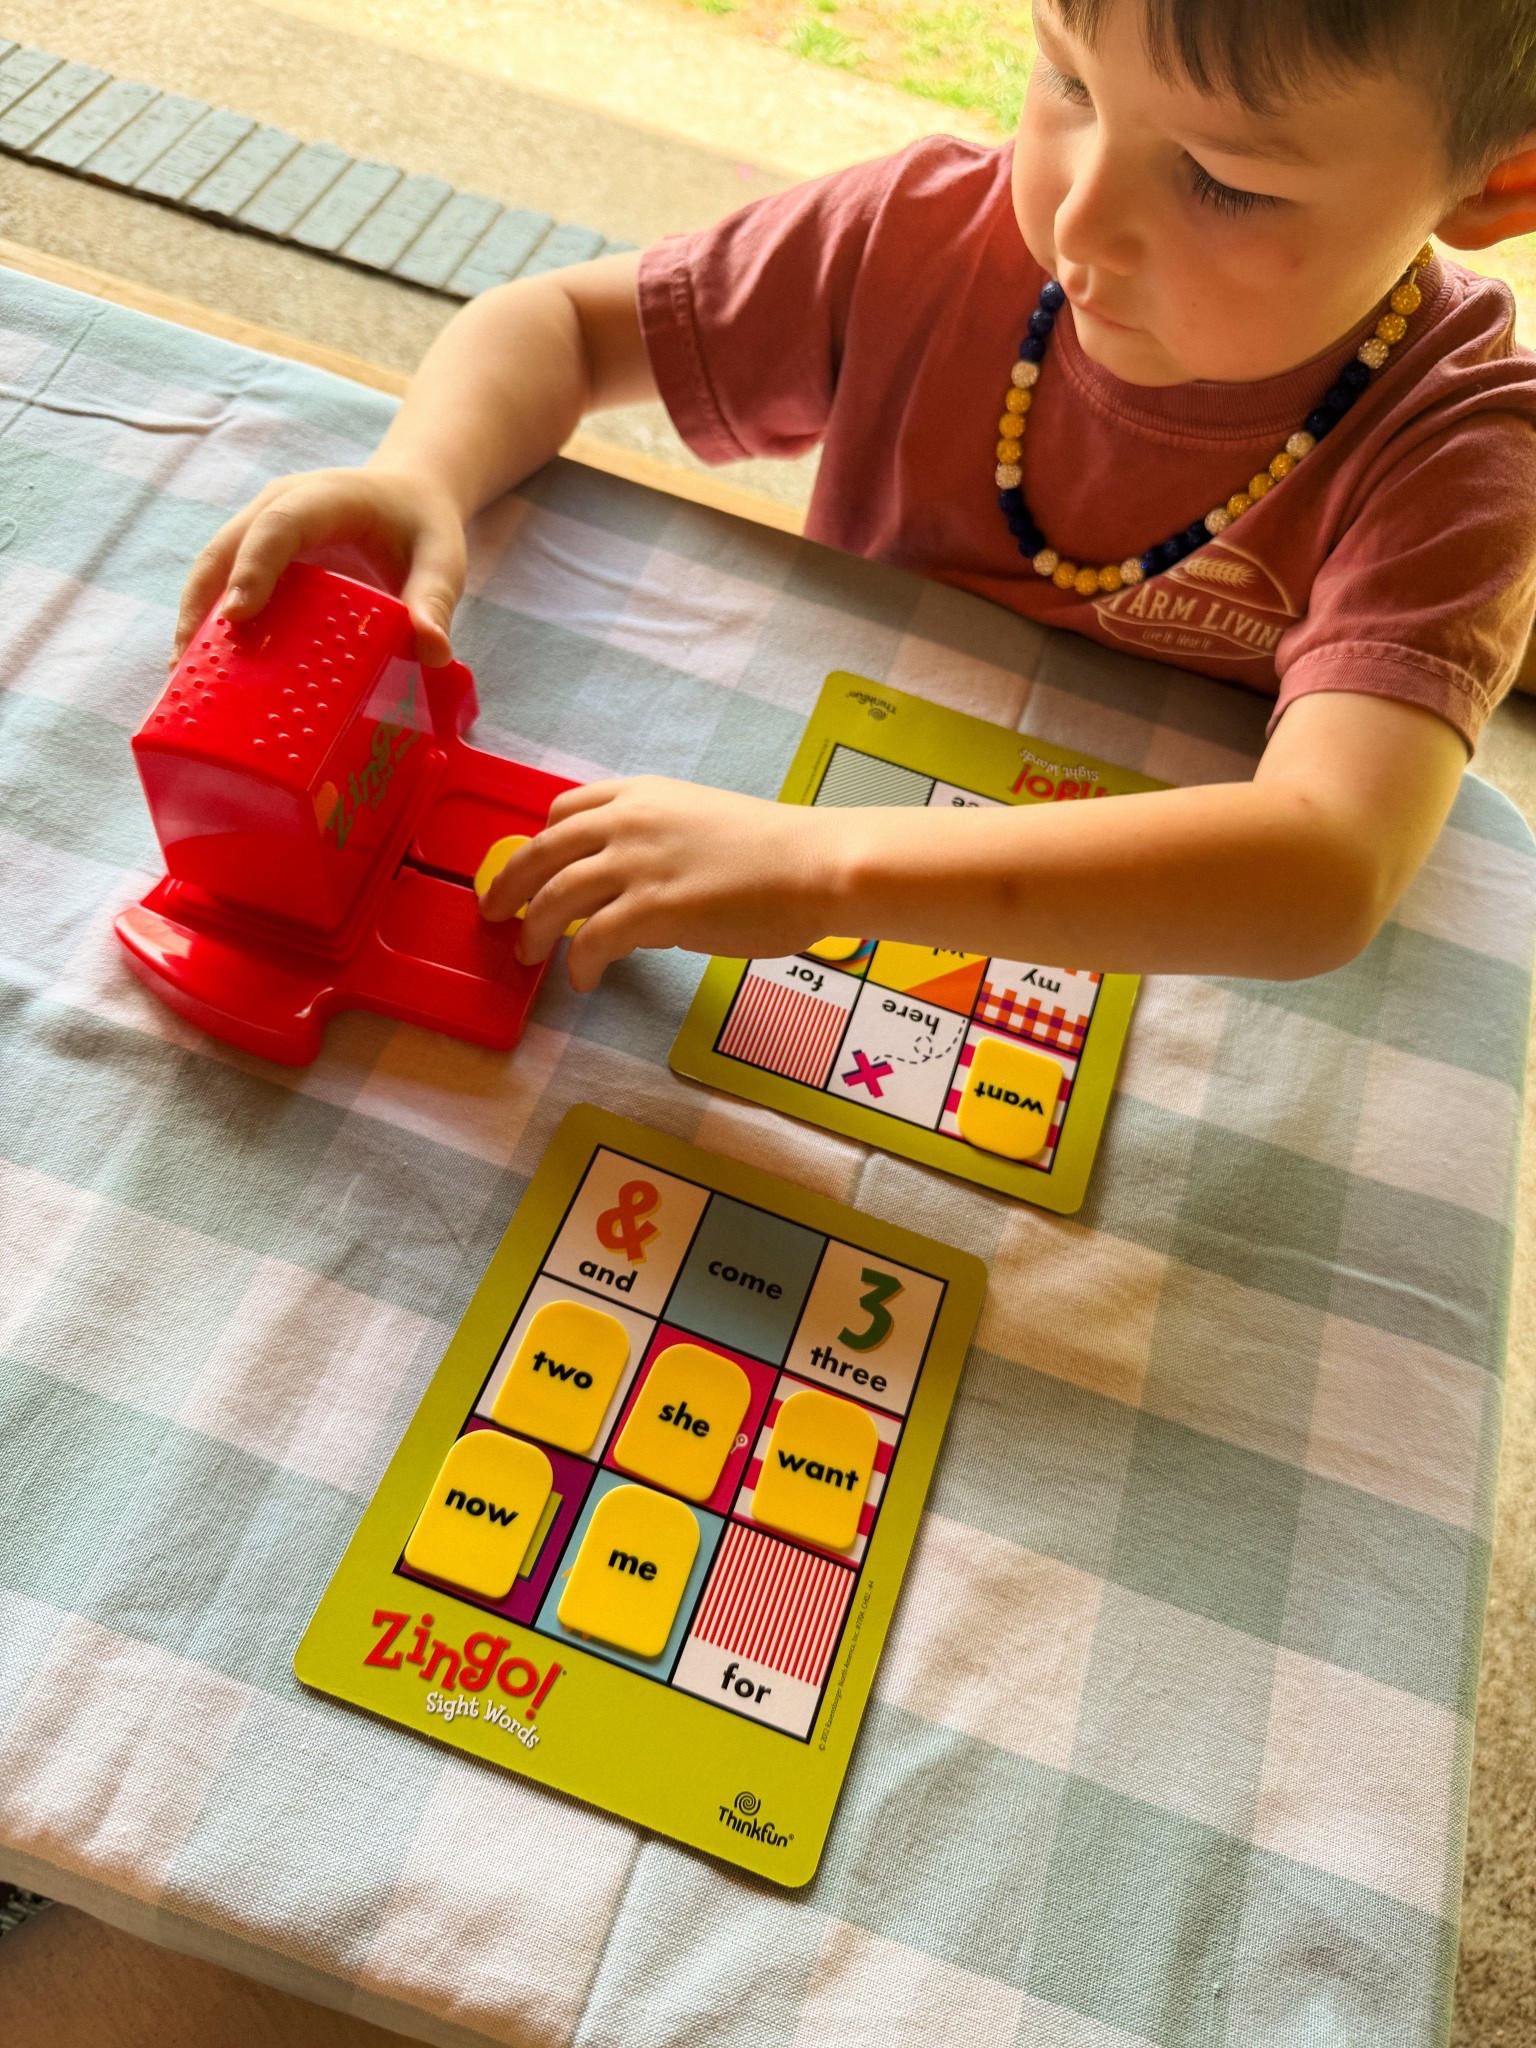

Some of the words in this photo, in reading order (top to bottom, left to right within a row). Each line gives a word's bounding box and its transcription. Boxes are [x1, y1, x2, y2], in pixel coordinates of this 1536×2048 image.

[1202, 602, 1284, 649] LIVIN
[1063, 764, 1099, 782] Sight
[786, 964, 825, 992] for
[1020, 968, 1061, 994] my
[882, 998, 940, 1035] here
[974, 1081, 1044, 1115] want
[578, 1257, 638, 1293] and
[707, 1259, 783, 1300] come
[837, 1267, 905, 1353] 3
[533, 1351, 593, 1390] two
[810, 1346, 888, 1393] three
[659, 1401, 711, 1438] she
[777, 1449, 859, 1492] want
[445, 1484, 519, 1528] now
[607, 1546, 658, 1582] me
[364, 1609, 563, 1720] Zingo!
[720, 1662, 772, 1704] for
[825, 1687, 842, 1728] Ravensburger
[838, 1668, 848, 1687] North
[426, 1692, 480, 1722] Sight
[483, 1700, 540, 1749] Words
